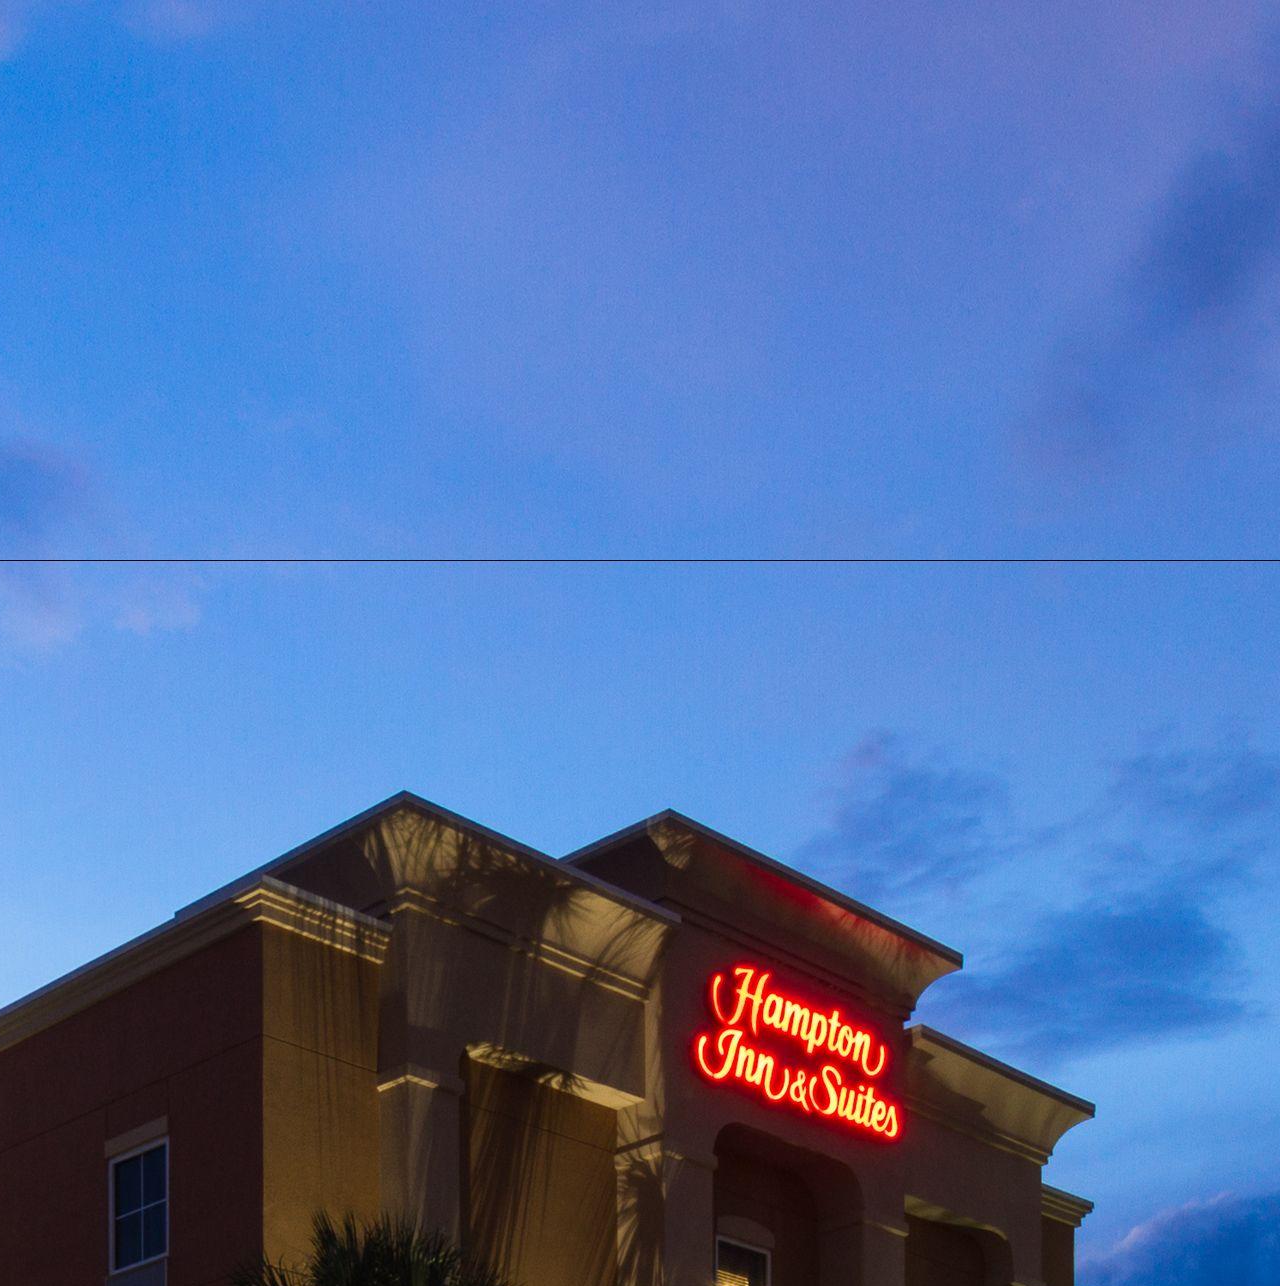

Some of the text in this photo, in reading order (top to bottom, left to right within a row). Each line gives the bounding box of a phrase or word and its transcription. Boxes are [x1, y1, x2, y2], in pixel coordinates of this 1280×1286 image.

[712, 966, 886, 1077] Hampton
[697, 1028, 899, 1138] Inn & Suites
